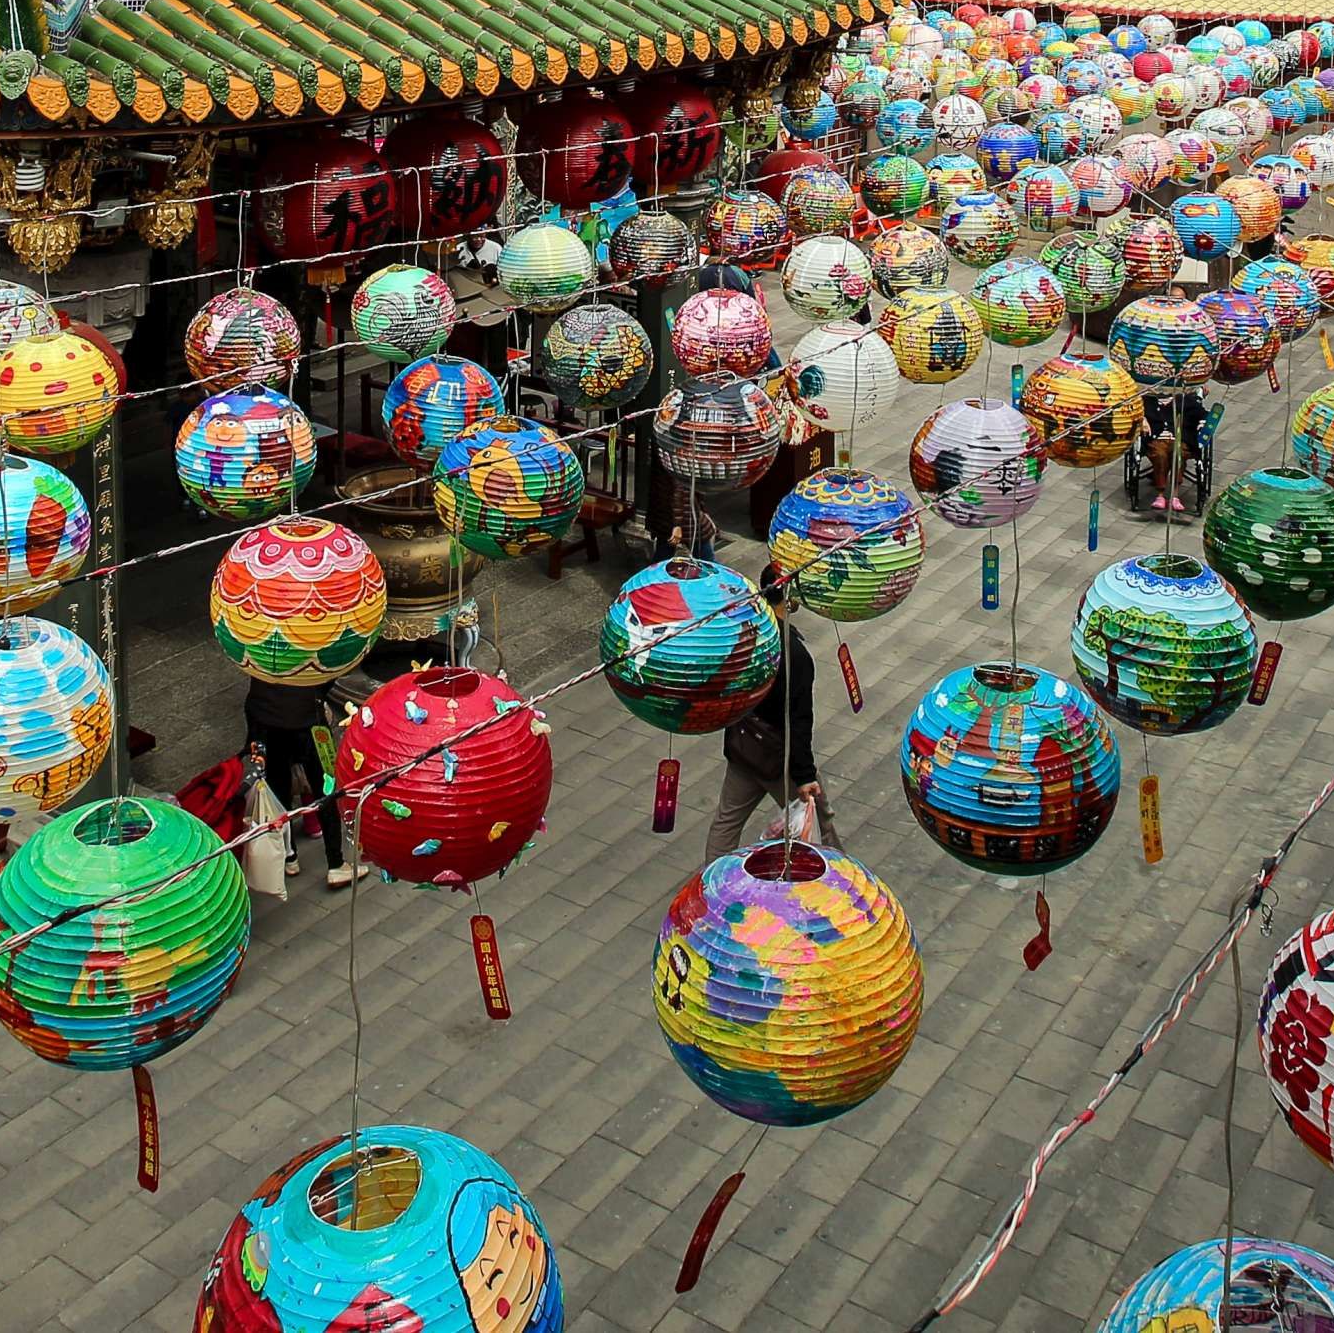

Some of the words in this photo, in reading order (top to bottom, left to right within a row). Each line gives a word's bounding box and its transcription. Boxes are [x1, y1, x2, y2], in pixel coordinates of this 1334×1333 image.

[580, 118, 633, 193] 春
[479, 941, 504, 1009] 國小低年級組
